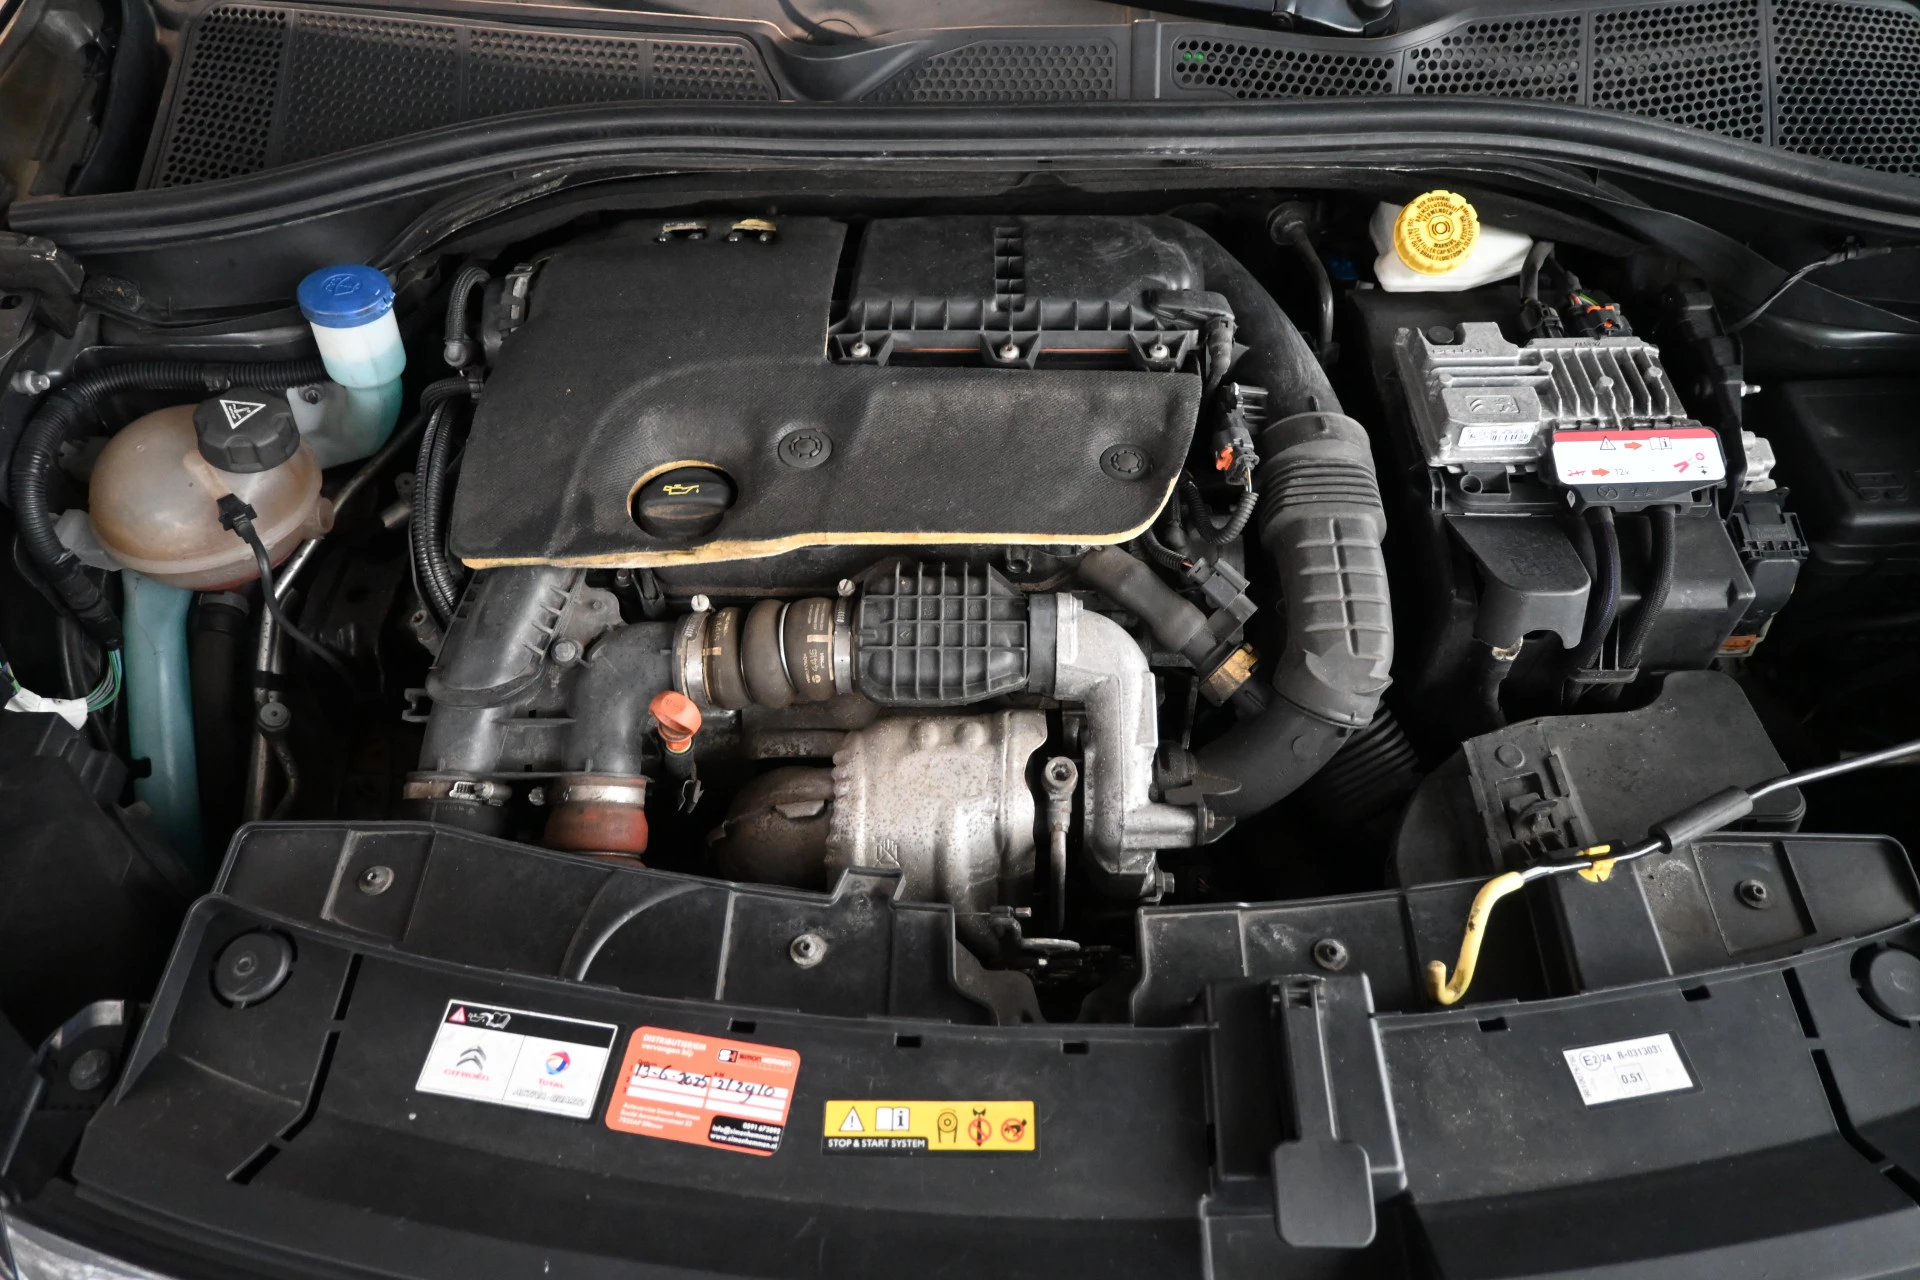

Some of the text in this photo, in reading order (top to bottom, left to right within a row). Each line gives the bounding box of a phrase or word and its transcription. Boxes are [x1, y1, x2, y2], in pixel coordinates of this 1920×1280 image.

[642, 1044, 681, 1055] vervangen
[1602, 1054, 1612, 1062] 24
[443, 1068, 489, 1081] CITROËN
[1621, 1072, 1643, 1084] 0.51
[828, 1139, 925, 1148] STOP & START SYSTEM
